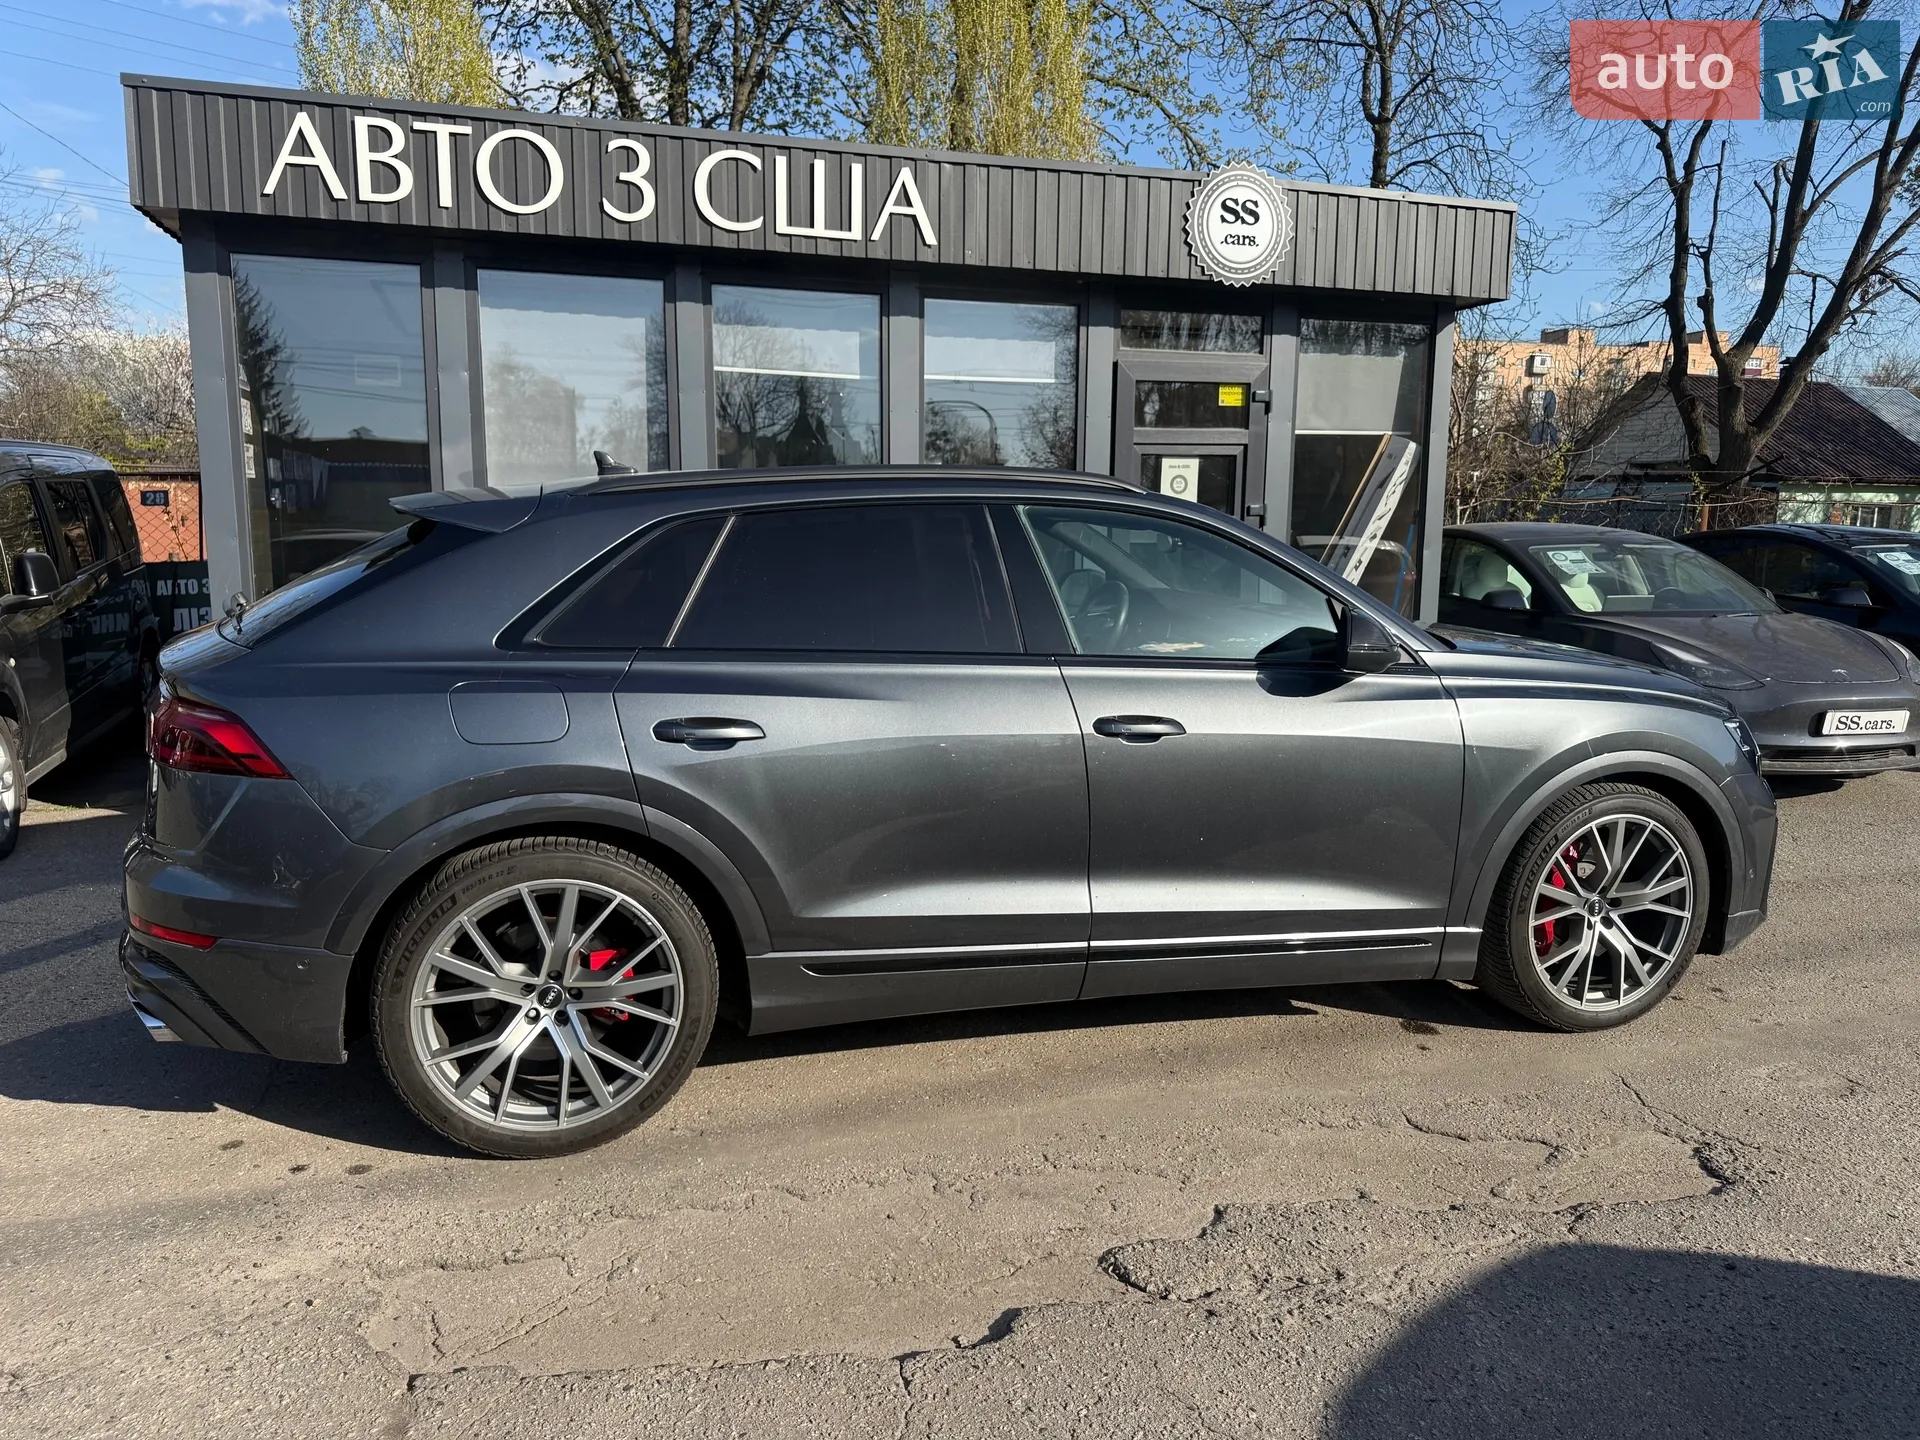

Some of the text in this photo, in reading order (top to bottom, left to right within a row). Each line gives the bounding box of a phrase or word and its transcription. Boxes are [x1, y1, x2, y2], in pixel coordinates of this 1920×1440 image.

[262, 111, 938, 246] АВТО З США
[1219, 197, 1260, 226] SS
[1835, 714, 1896, 731] SS.cars.
[1522, 836, 1558, 898] MICHELIN
[397, 899, 454, 975] MICHELIN
